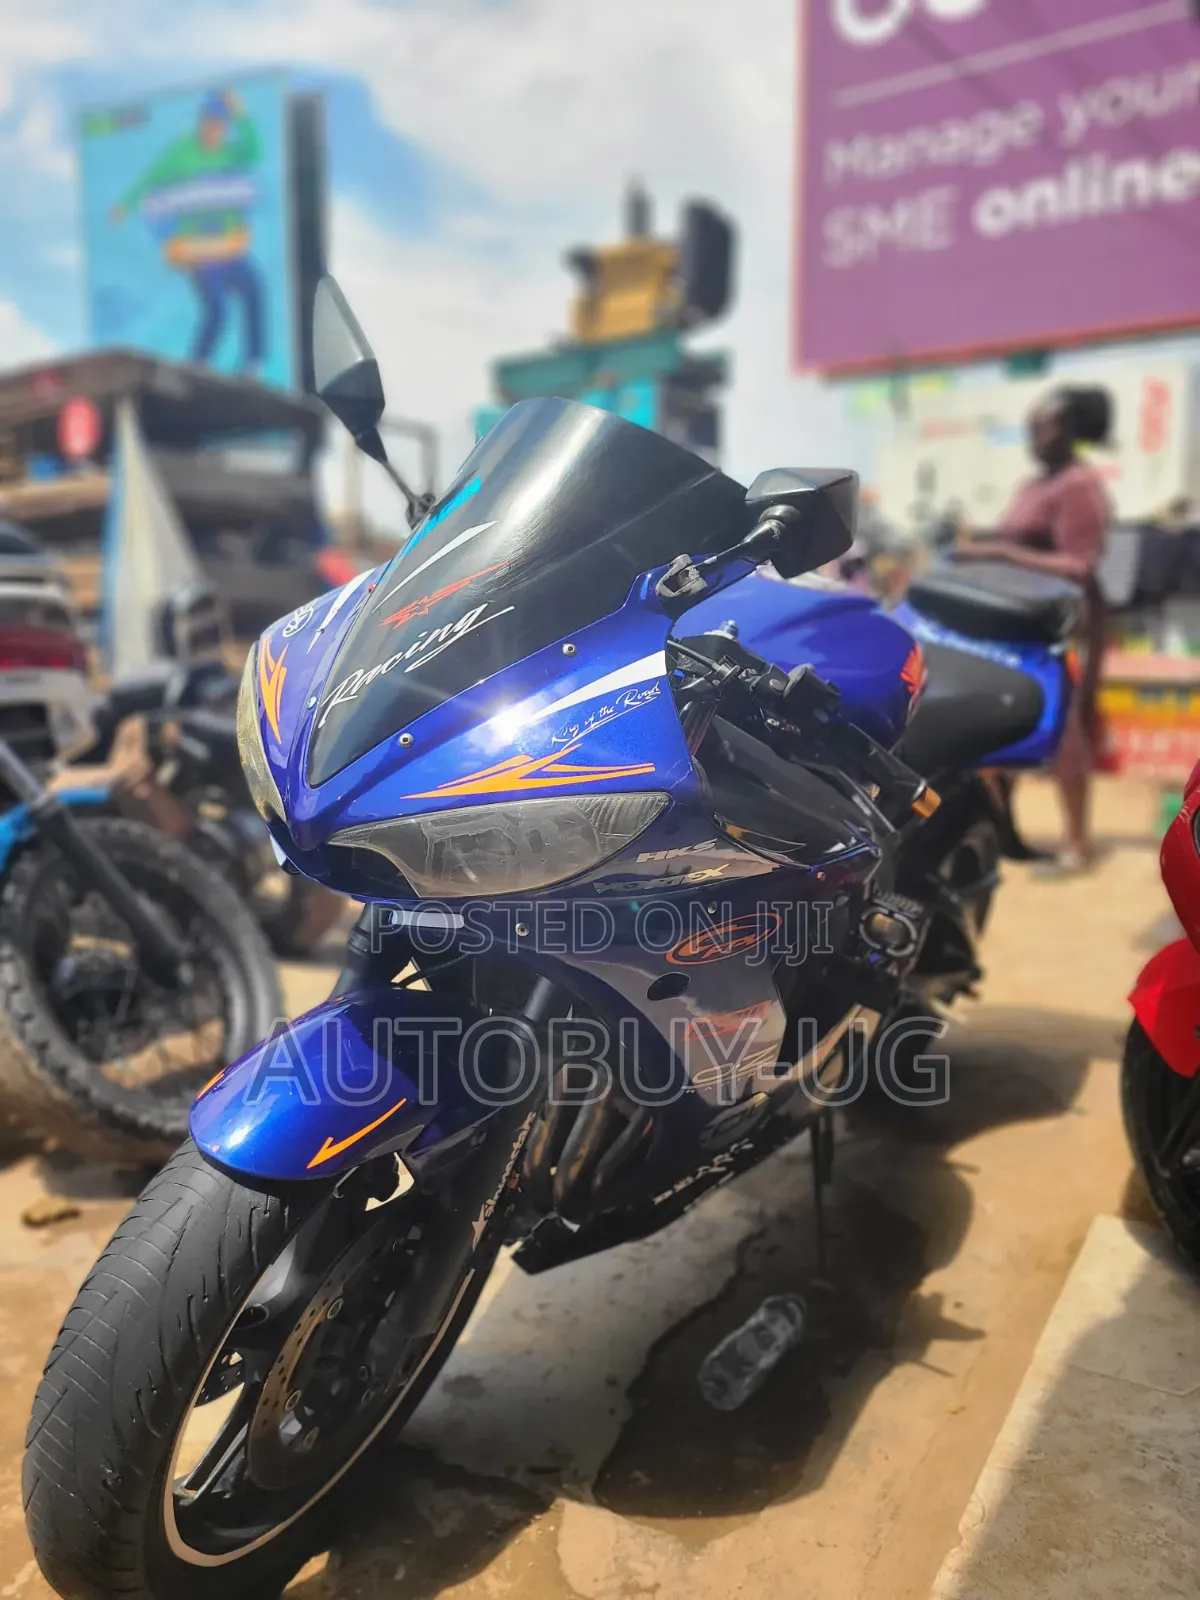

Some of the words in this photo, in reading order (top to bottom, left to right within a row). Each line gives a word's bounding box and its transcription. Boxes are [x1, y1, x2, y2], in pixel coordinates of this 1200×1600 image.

[823, 100, 1044, 190] Manage
[821, 185, 961, 269] SME
[972, 148, 1200, 240] online
[318, 603, 515, 728] Racing
[636, 838, 718, 863] HKS
